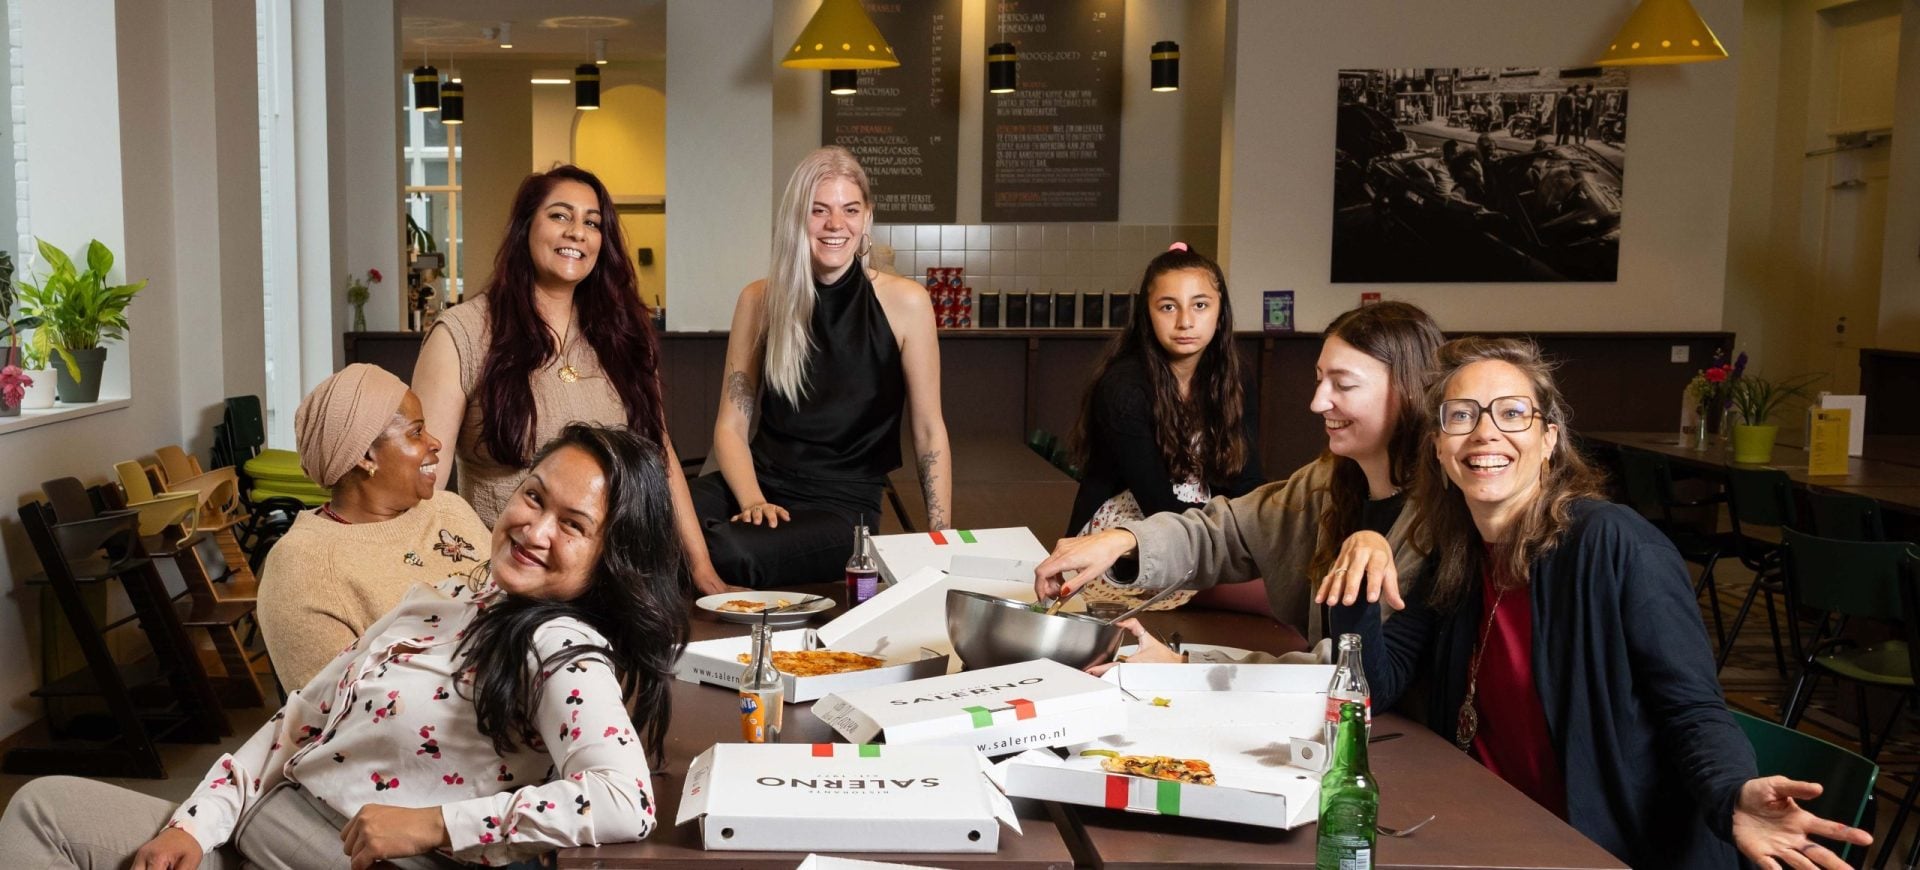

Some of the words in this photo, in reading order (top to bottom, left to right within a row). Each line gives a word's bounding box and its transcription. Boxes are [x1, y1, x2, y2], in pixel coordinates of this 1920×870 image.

[693, 667, 741, 684] www.salern
[889, 677, 1044, 705] SALERNO
[977, 727, 1066, 752] w.salerno.nl
[756, 776, 940, 789] SALERNO
